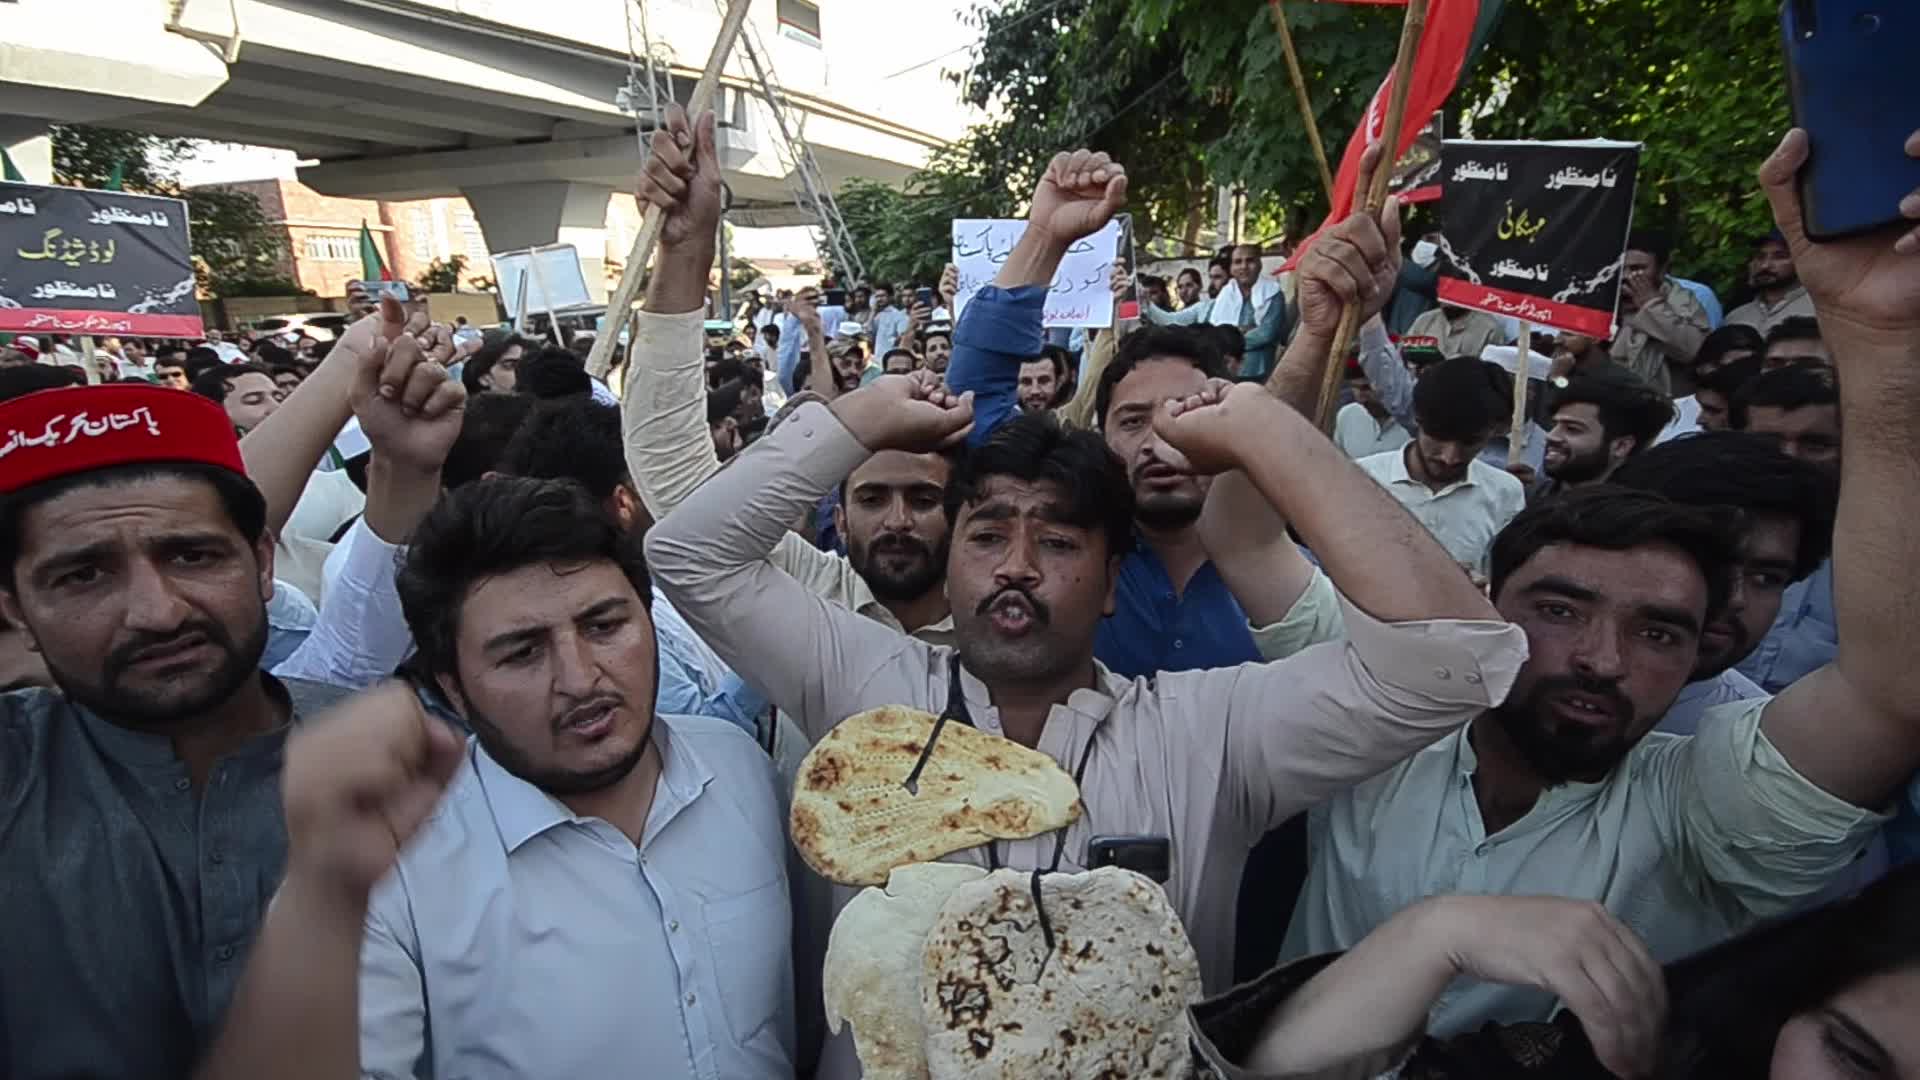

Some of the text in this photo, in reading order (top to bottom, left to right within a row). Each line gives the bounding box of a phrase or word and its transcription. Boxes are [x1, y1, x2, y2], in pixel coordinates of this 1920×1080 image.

[1452, 160, 1508, 182] نامنظور
[1545, 167, 1617, 190] نامنظور
[88, 206, 169, 227] نامنظور
[1497, 198, 1546, 244] مہنگائی
[1489, 258, 1550, 282] نامنظور
[31, 280, 117, 299] نامنظور
[26, 411, 90, 447] تحریک
[81, 407, 161, 437] پاکستان
